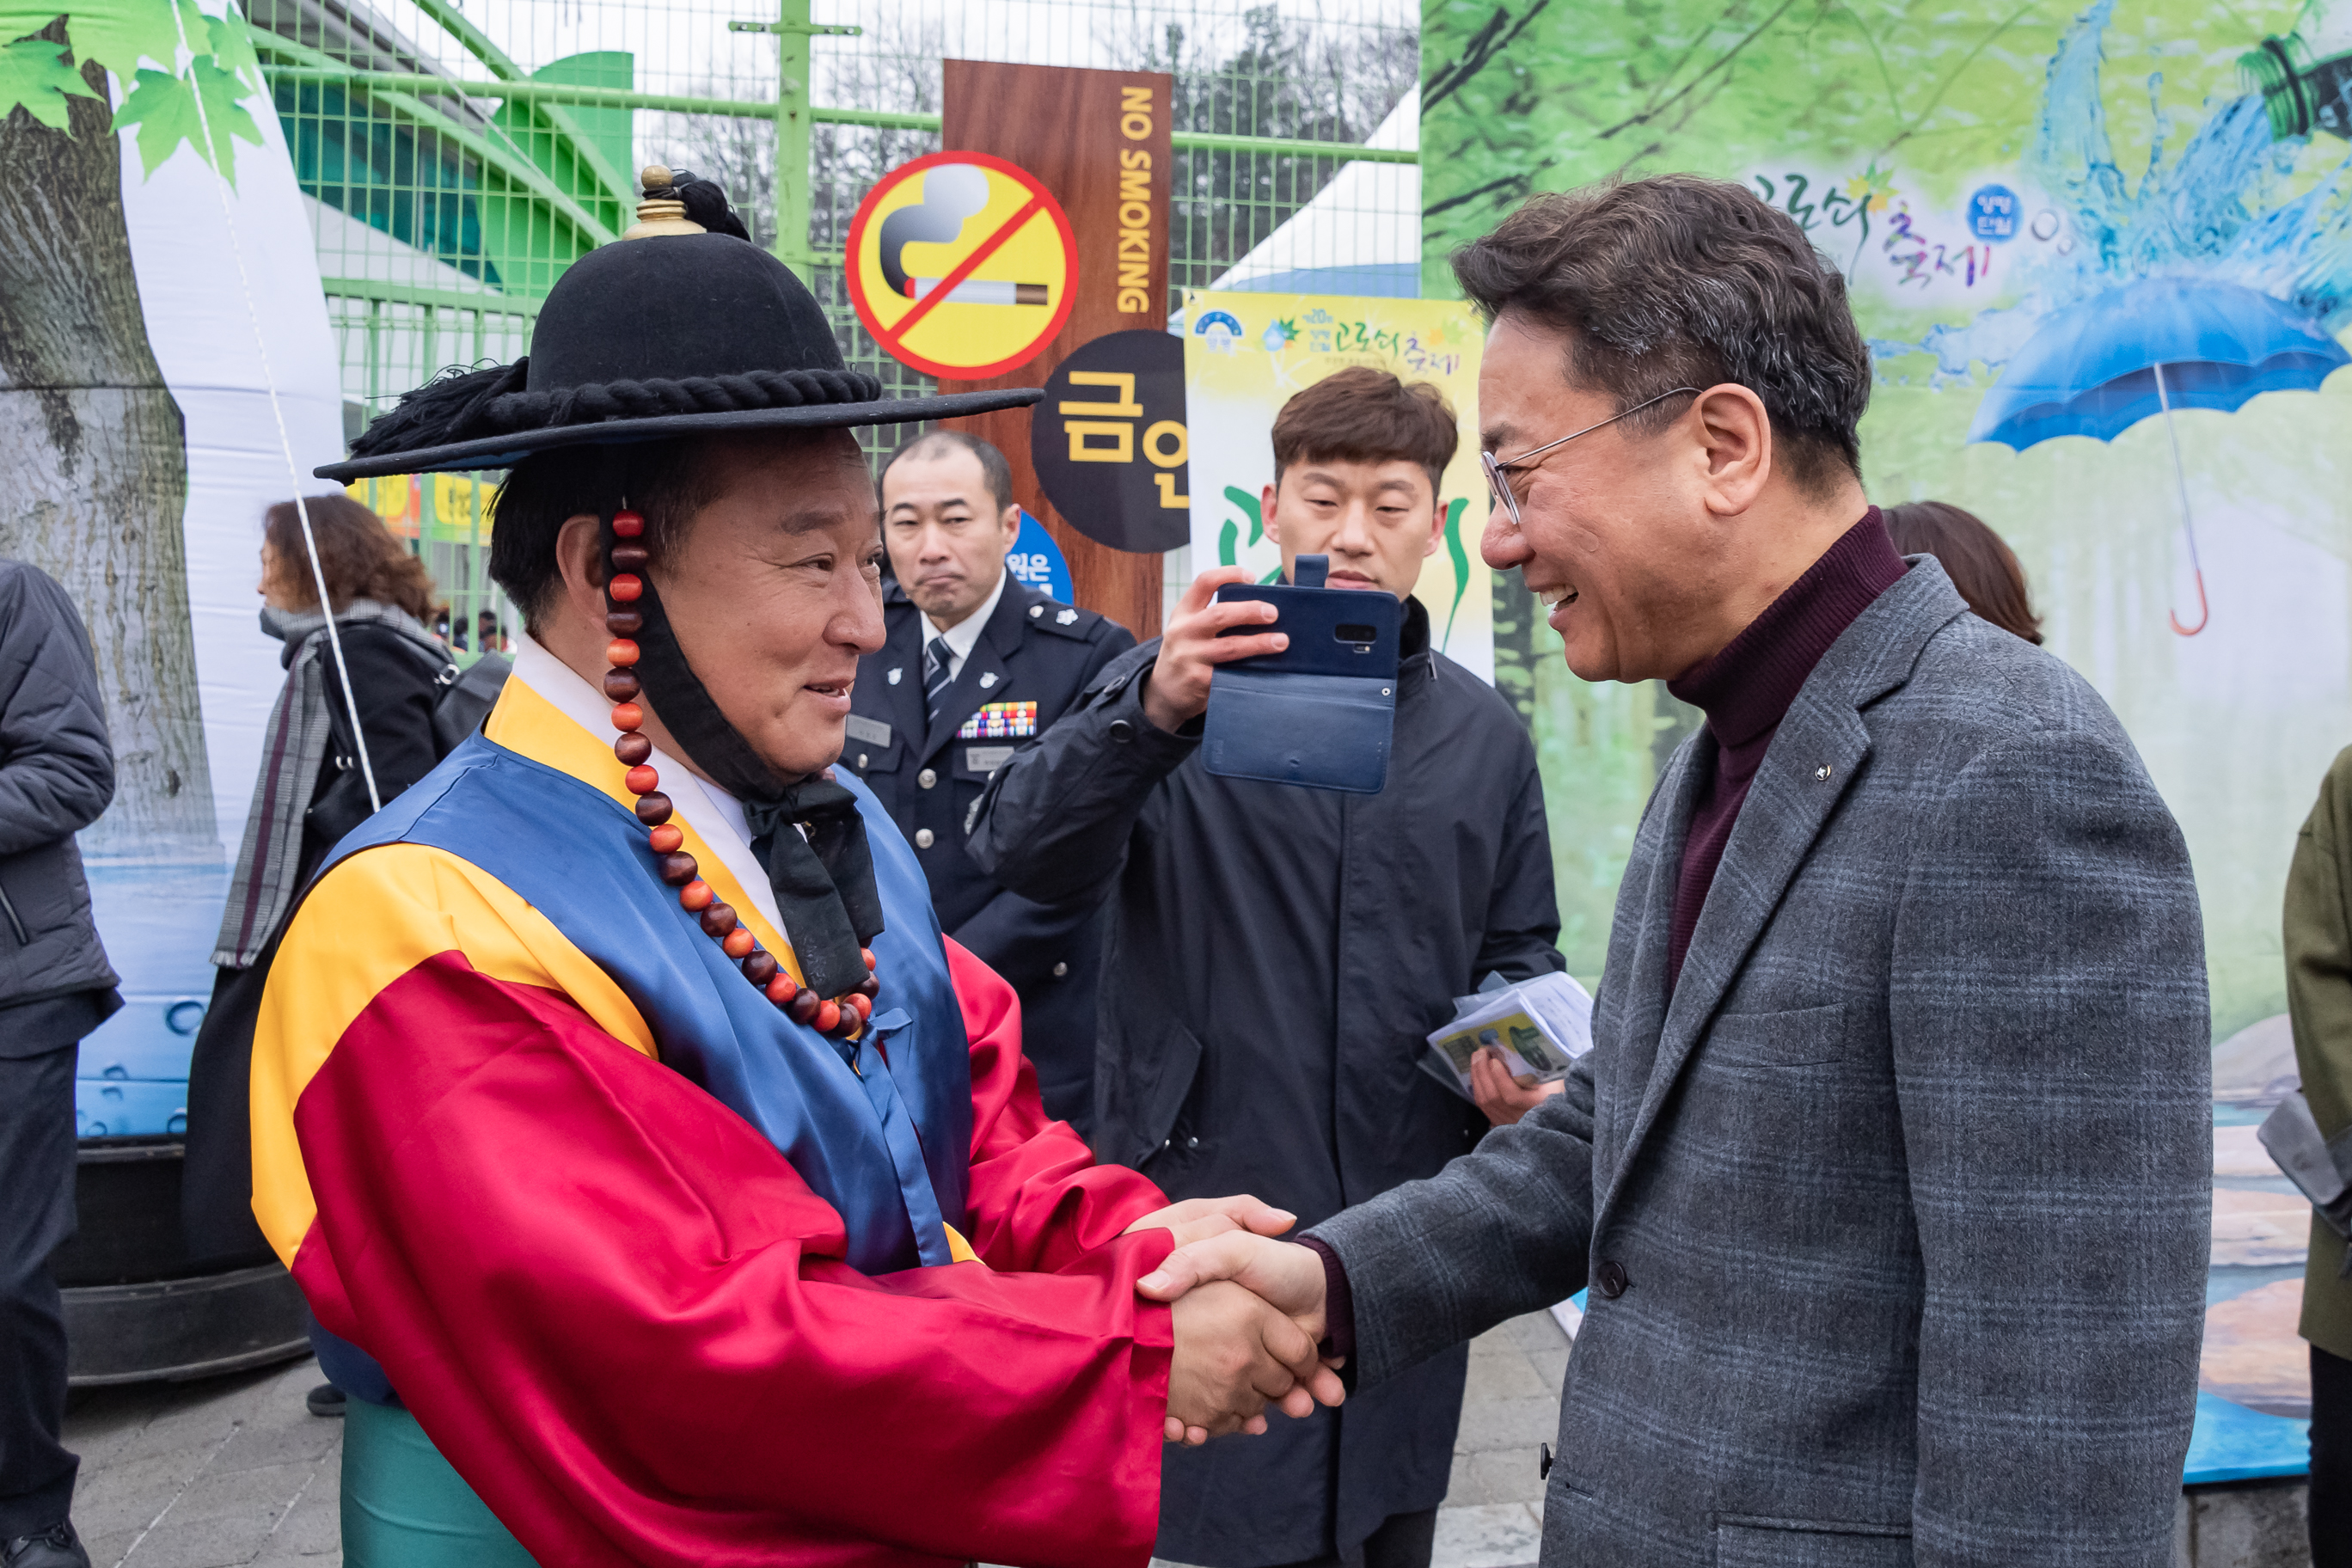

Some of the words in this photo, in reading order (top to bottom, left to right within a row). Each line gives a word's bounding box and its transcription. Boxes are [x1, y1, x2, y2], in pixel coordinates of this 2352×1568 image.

[1120, 87, 1154, 140] NO
[1117, 149, 1152, 313] SMOKING
[1883, 200, 1991, 288] 축제
